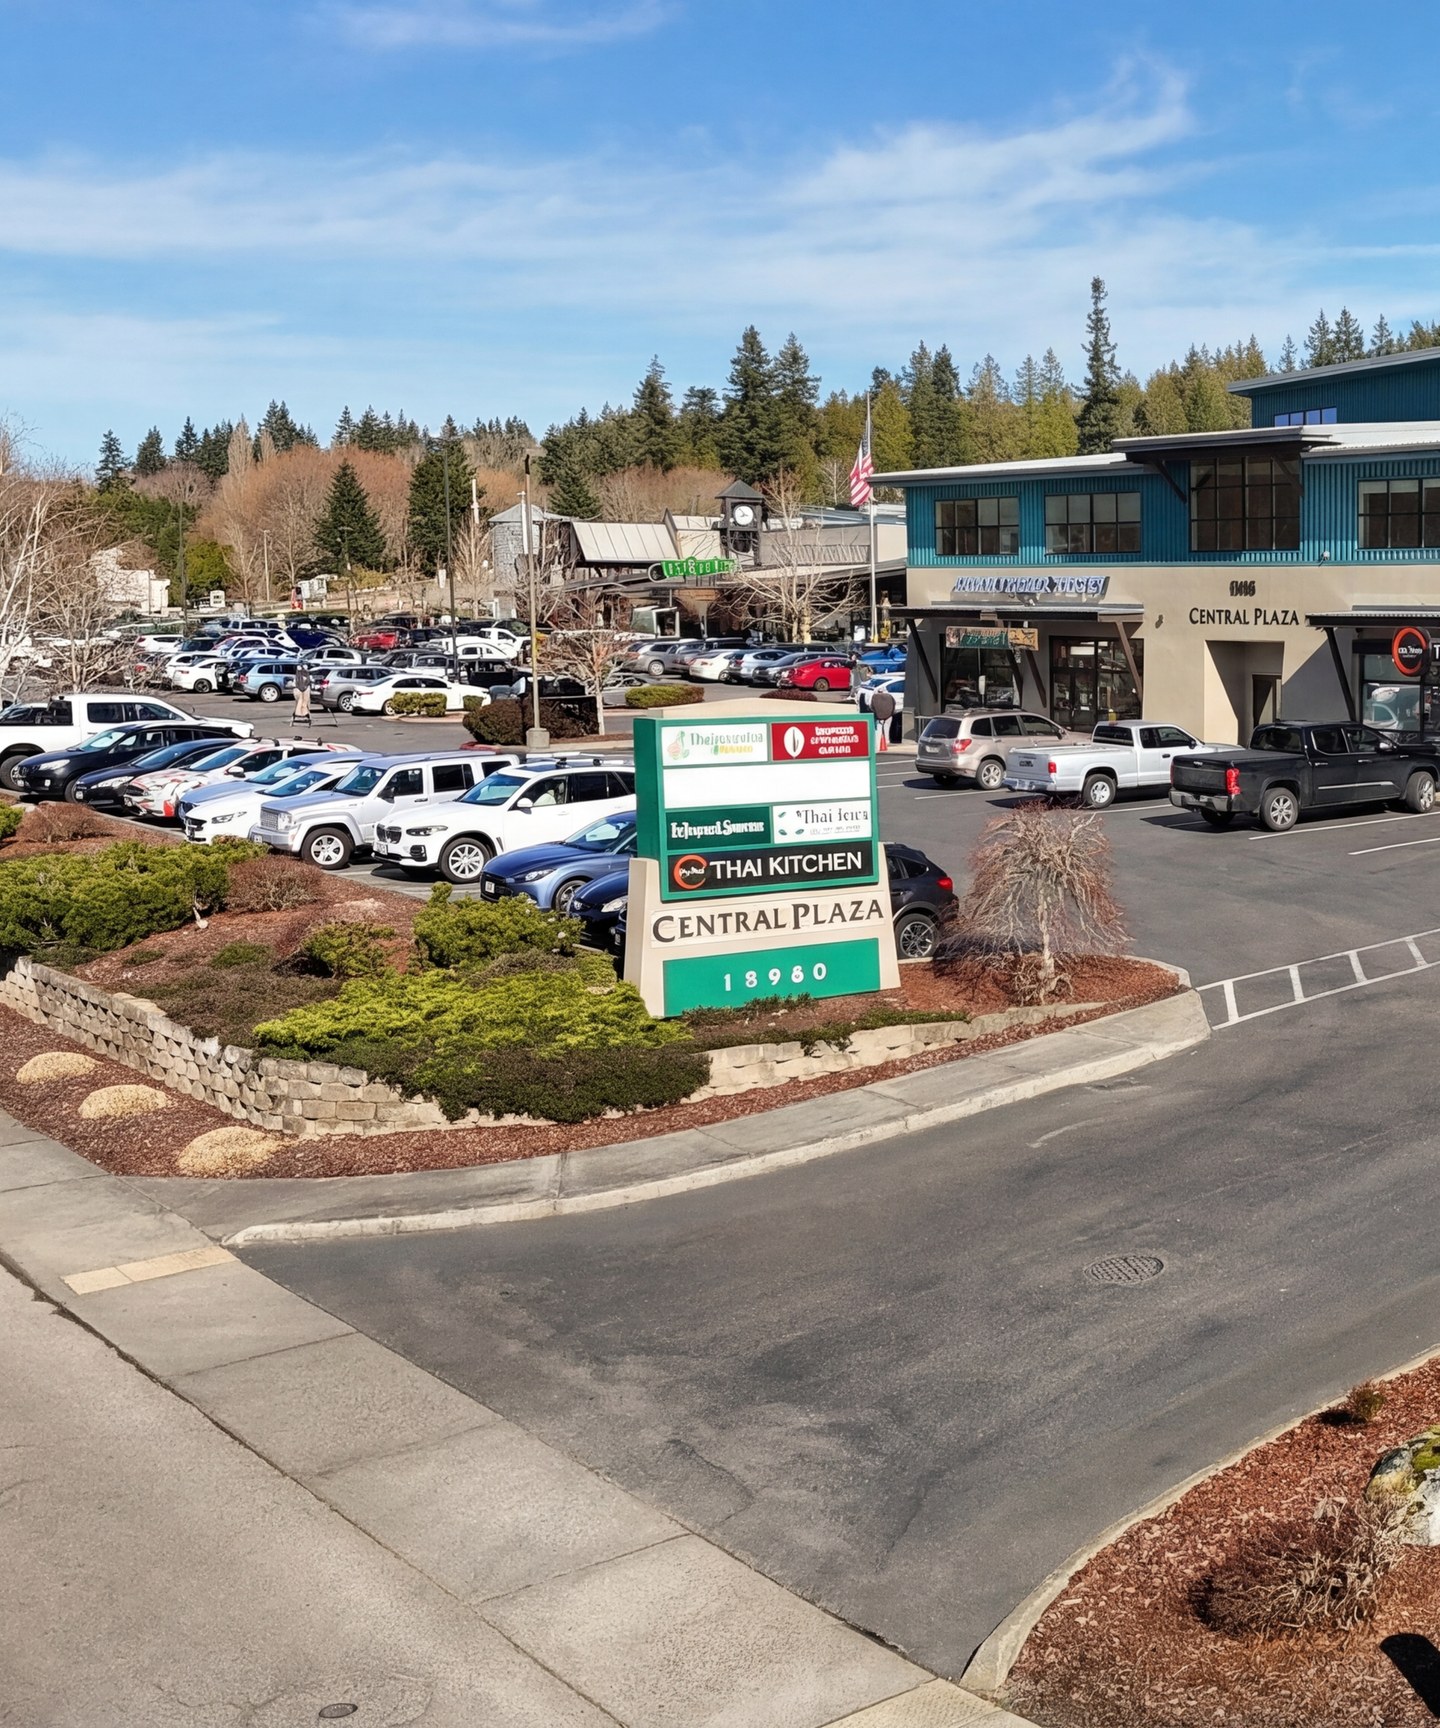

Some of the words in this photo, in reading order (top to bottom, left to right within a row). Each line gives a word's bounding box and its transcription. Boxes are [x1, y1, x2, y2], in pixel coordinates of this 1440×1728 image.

[1189, 607, 1249, 625] CENTRAL
[1254, 608, 1299, 625] PLAZA
[710, 859, 762, 880] THAI
[769, 851, 862, 876] KITCHEN
[653, 907, 787, 943] CENTRAL
[792, 899, 885, 930] PLAZA
